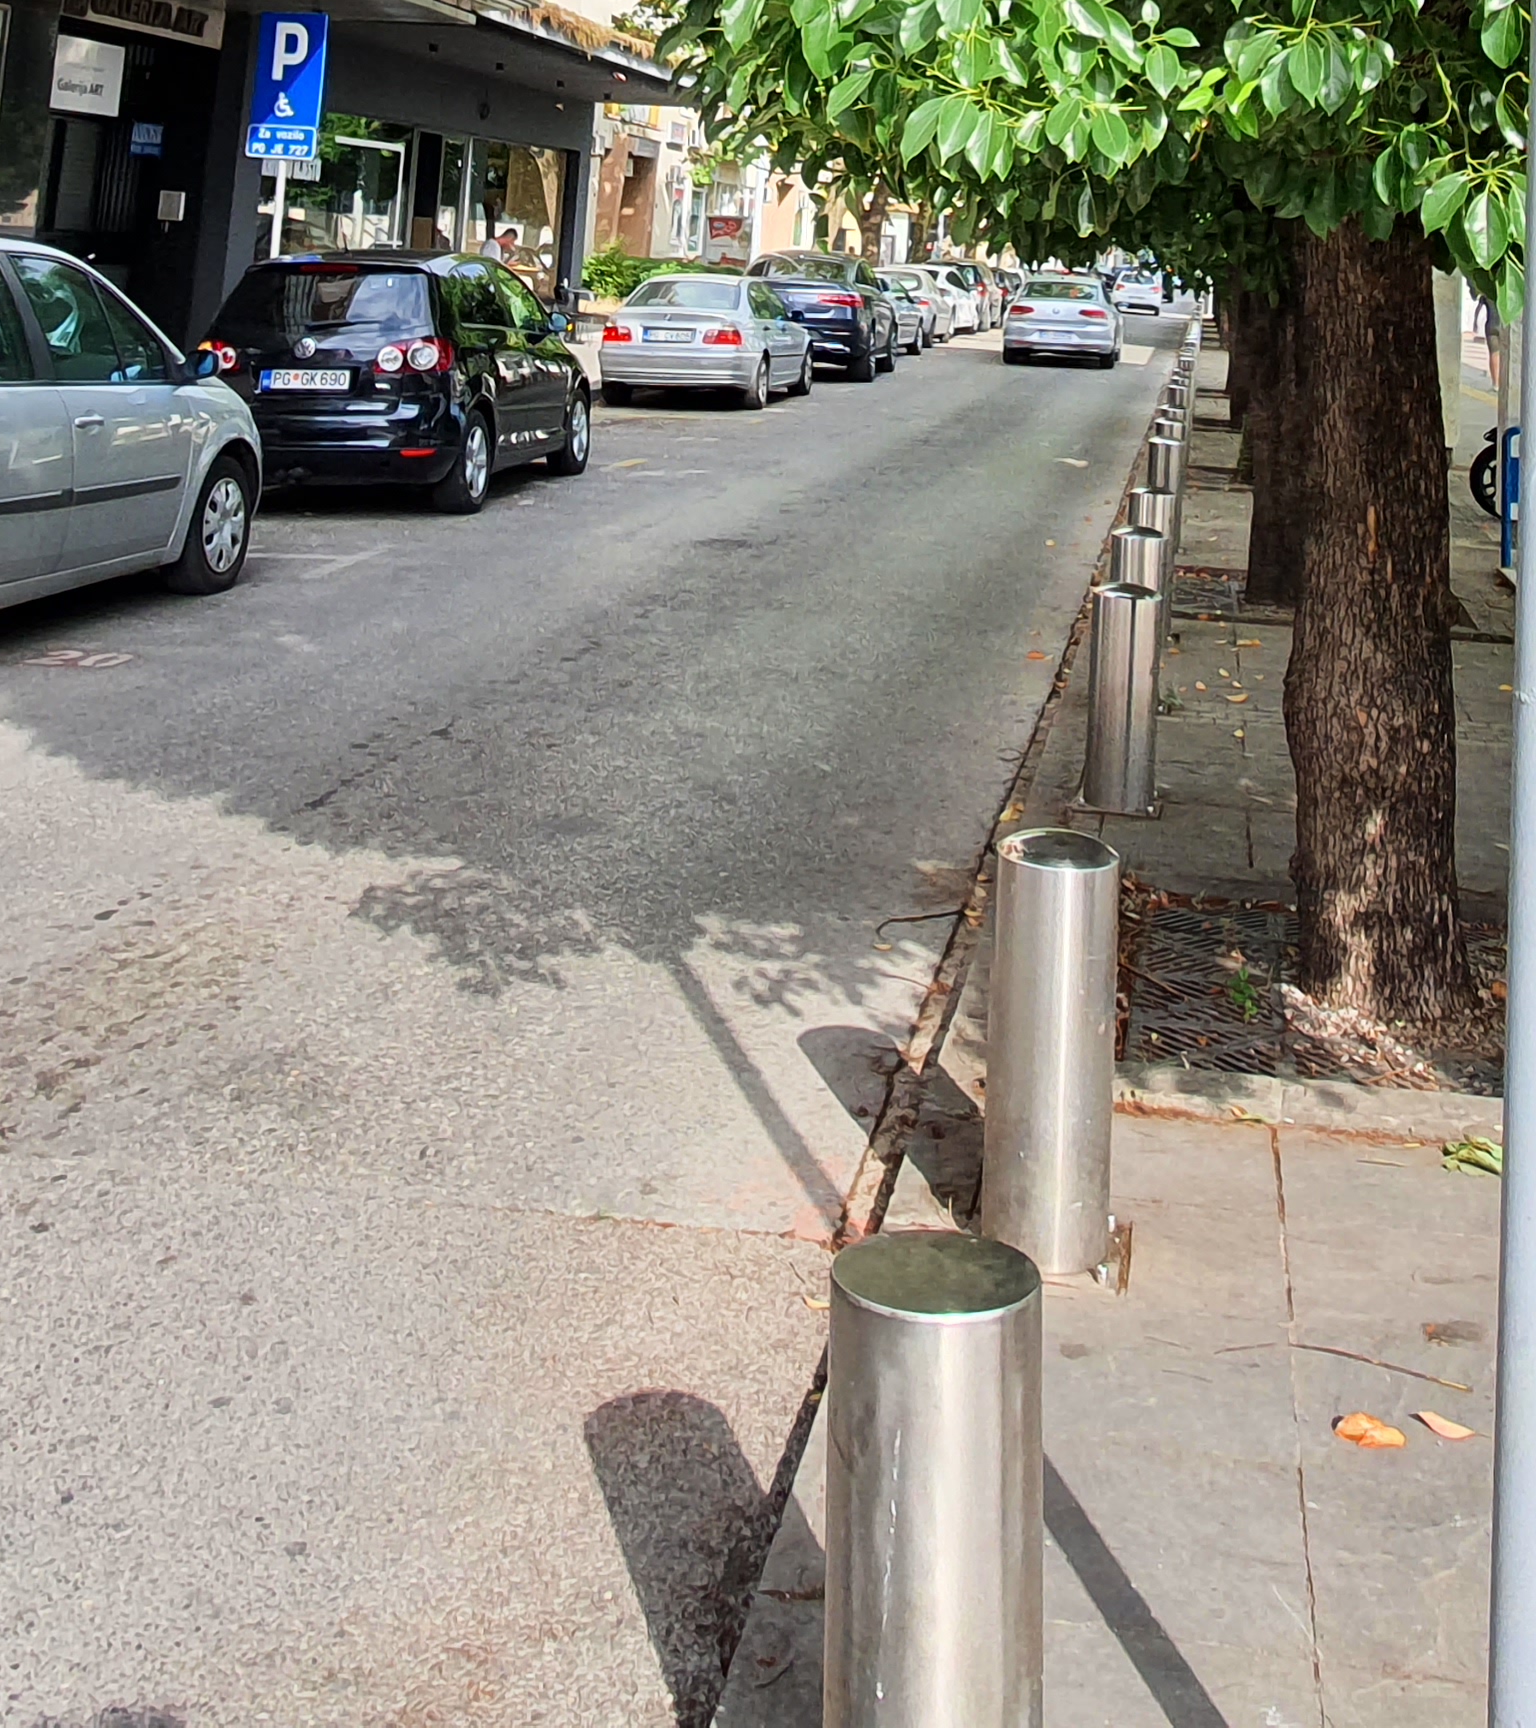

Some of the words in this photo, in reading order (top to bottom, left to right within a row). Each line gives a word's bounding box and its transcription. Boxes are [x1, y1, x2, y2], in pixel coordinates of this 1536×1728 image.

[172, 6, 209, 38] ART
[271, 22, 309, 80] P
[258, 127, 271, 139] Za
[276, 129, 305, 141] vozilo
[270, 143, 284, 155] JE
[288, 144, 309, 156] 727
[273, 372, 291, 385] PG
